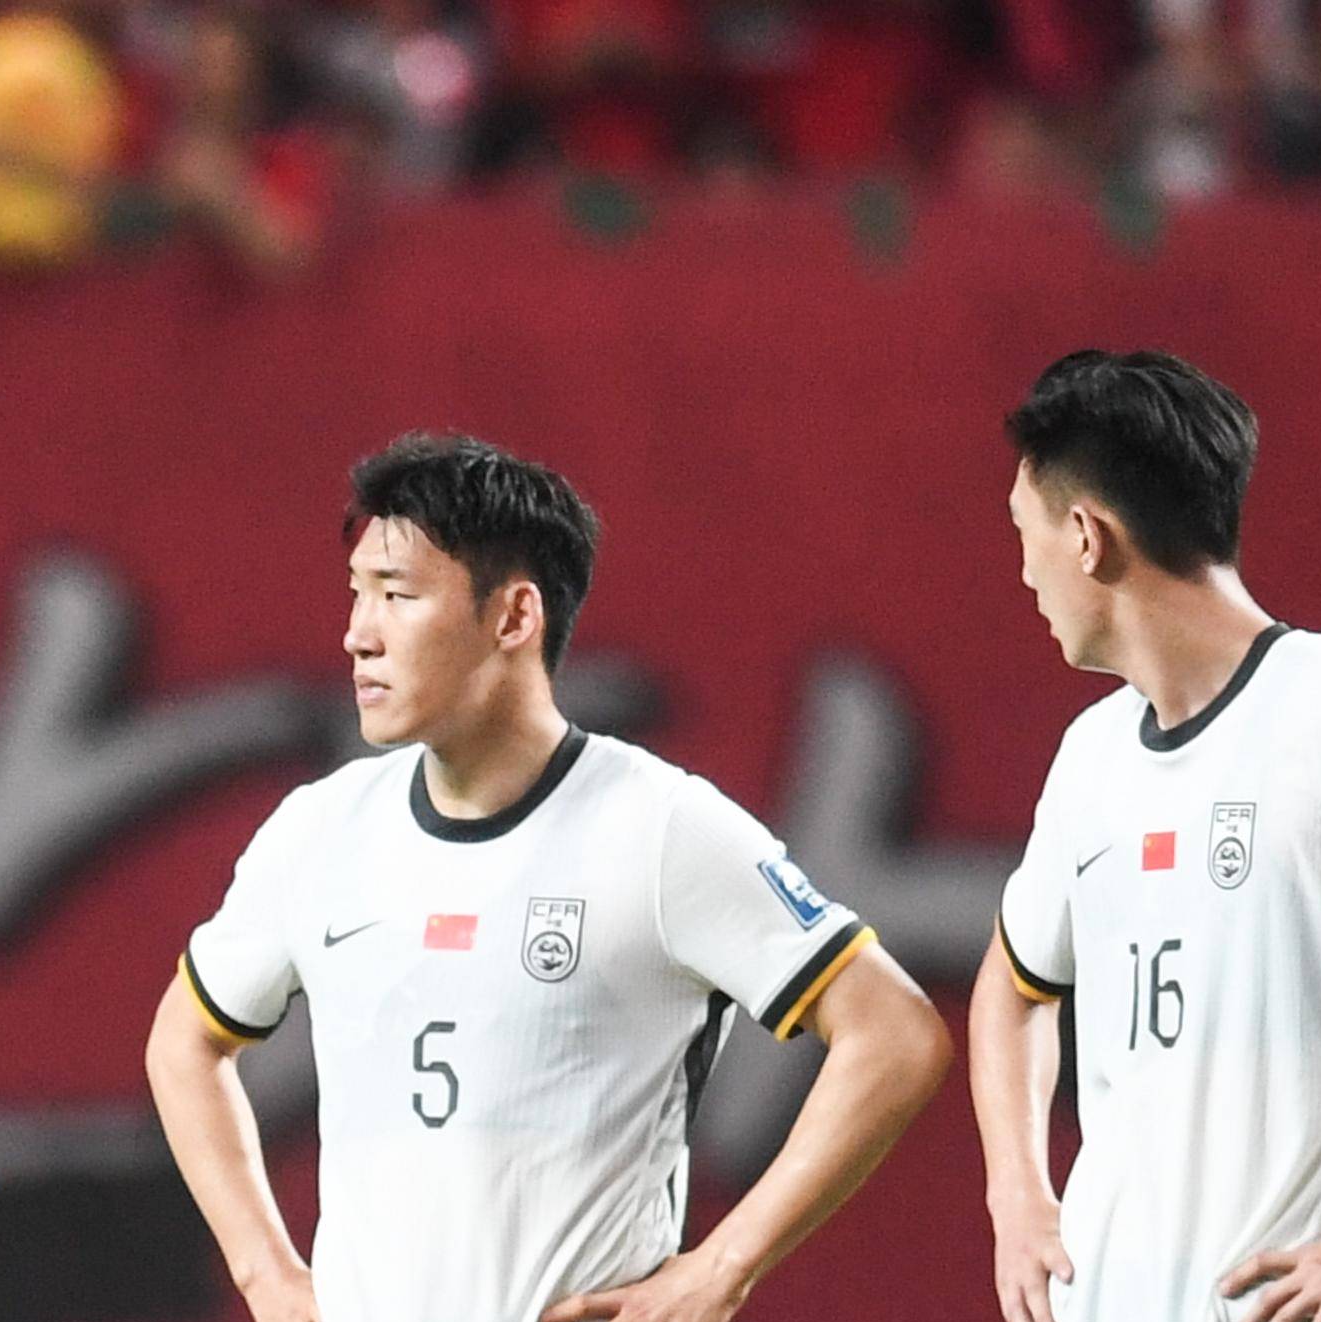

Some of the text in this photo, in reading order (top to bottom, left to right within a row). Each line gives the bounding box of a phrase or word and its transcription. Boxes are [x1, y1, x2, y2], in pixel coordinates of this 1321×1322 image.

[533, 902, 579, 918] CFA
[1129, 938, 1184, 1051] 16
[412, 1021, 459, 1128] 5
